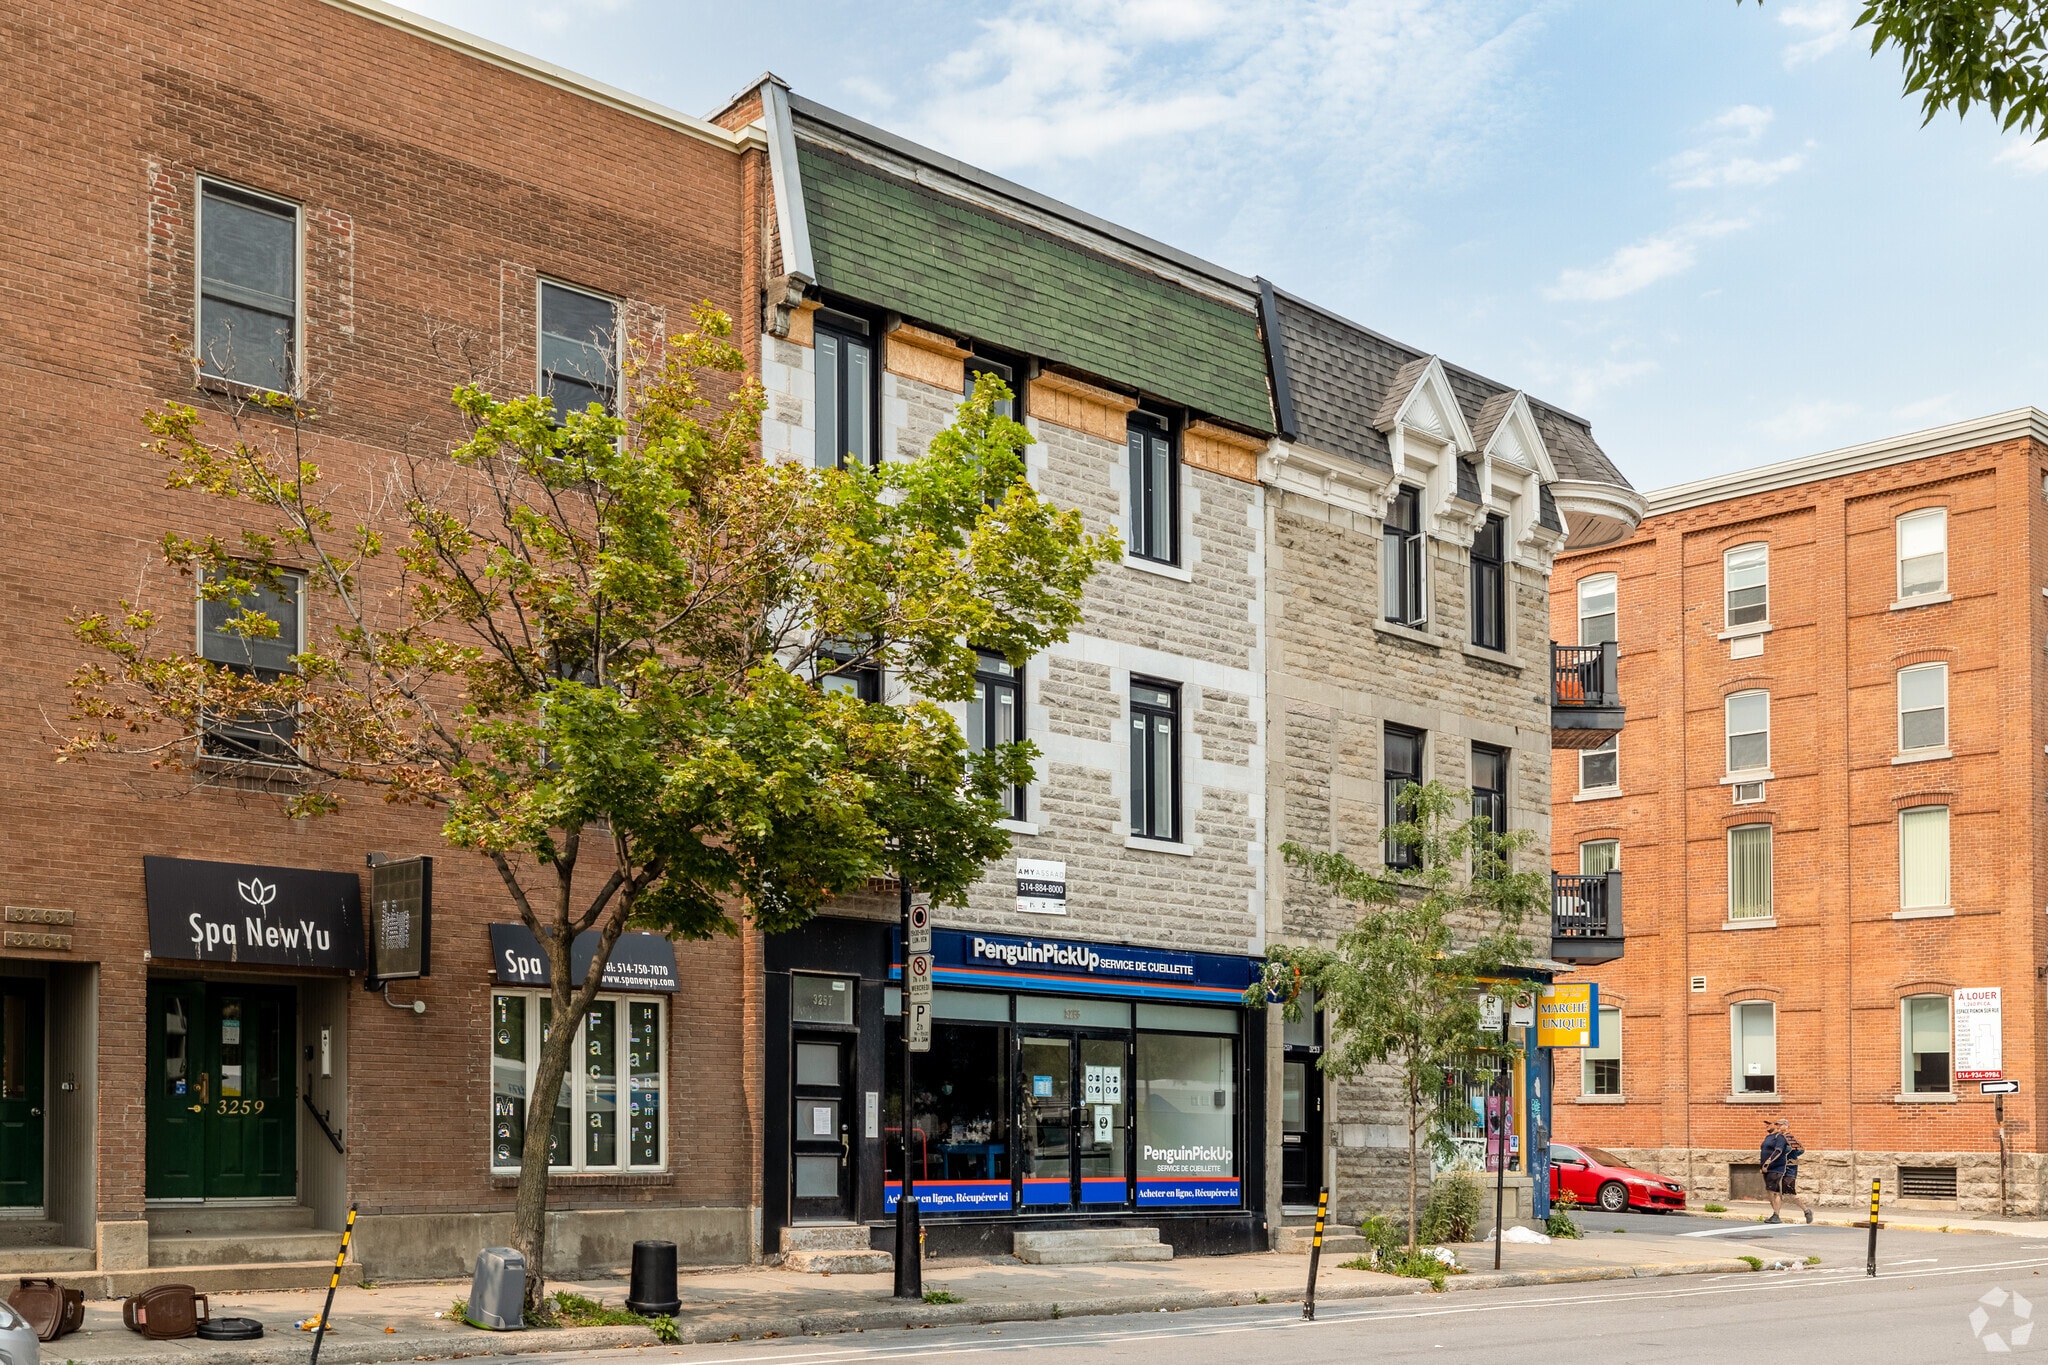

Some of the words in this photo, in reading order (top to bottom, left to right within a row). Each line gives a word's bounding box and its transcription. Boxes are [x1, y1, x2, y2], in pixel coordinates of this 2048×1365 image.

[1018, 868, 1034, 876] AMY
[1020, 882, 1064, 894] 514-884-8000
[15, 908, 66, 924] 3263
[189, 912, 237, 952] Spa
[245, 916, 331, 951] NewYu
[13, 933, 62, 948] 3261
[973, 937, 1100, 972] PenguinPickUp
[1099, 958, 1134, 971] SERVICE
[1135, 961, 1147, 972] DE
[1148, 962, 1193, 976] CUEILLETTE
[505, 949, 542, 981] Spa
[617, 962, 669, 976] 514-750-7070
[601, 974, 675, 988] www.spanewyu.com
[911, 984, 930, 992] MERCREDI
[812, 993, 833, 1007] 3257
[1958, 990, 1965, 1001] À
[1966, 991, 1997, 1001] LOUER
[916, 1005, 925, 1022] P
[1541, 1000, 1589, 1014] MARCHÉ
[1542, 1017, 1587, 1032] UNIQUE
[643, 1008, 653, 1061] Hair
[216, 1099, 265, 1115] 3259
[643, 1077, 654, 1158] Remove
[1143, 1145, 1233, 1165] PenguinPickUp
[1156, 1164, 1180, 1172] SERVICE
[932, 1193, 955, 1205] ligne,
[956, 1192, 998, 1204] Récupérer
[998, 1192, 1009, 1202] ici
[1138, 1188, 1166, 1198] Acheter
[1166, 1190, 1175, 1198] en
[1175, 1188, 1194, 1200] ligne,
[1195, 1187, 1230, 1200] Récupérer
[1230, 1188, 1238, 1197] ici
